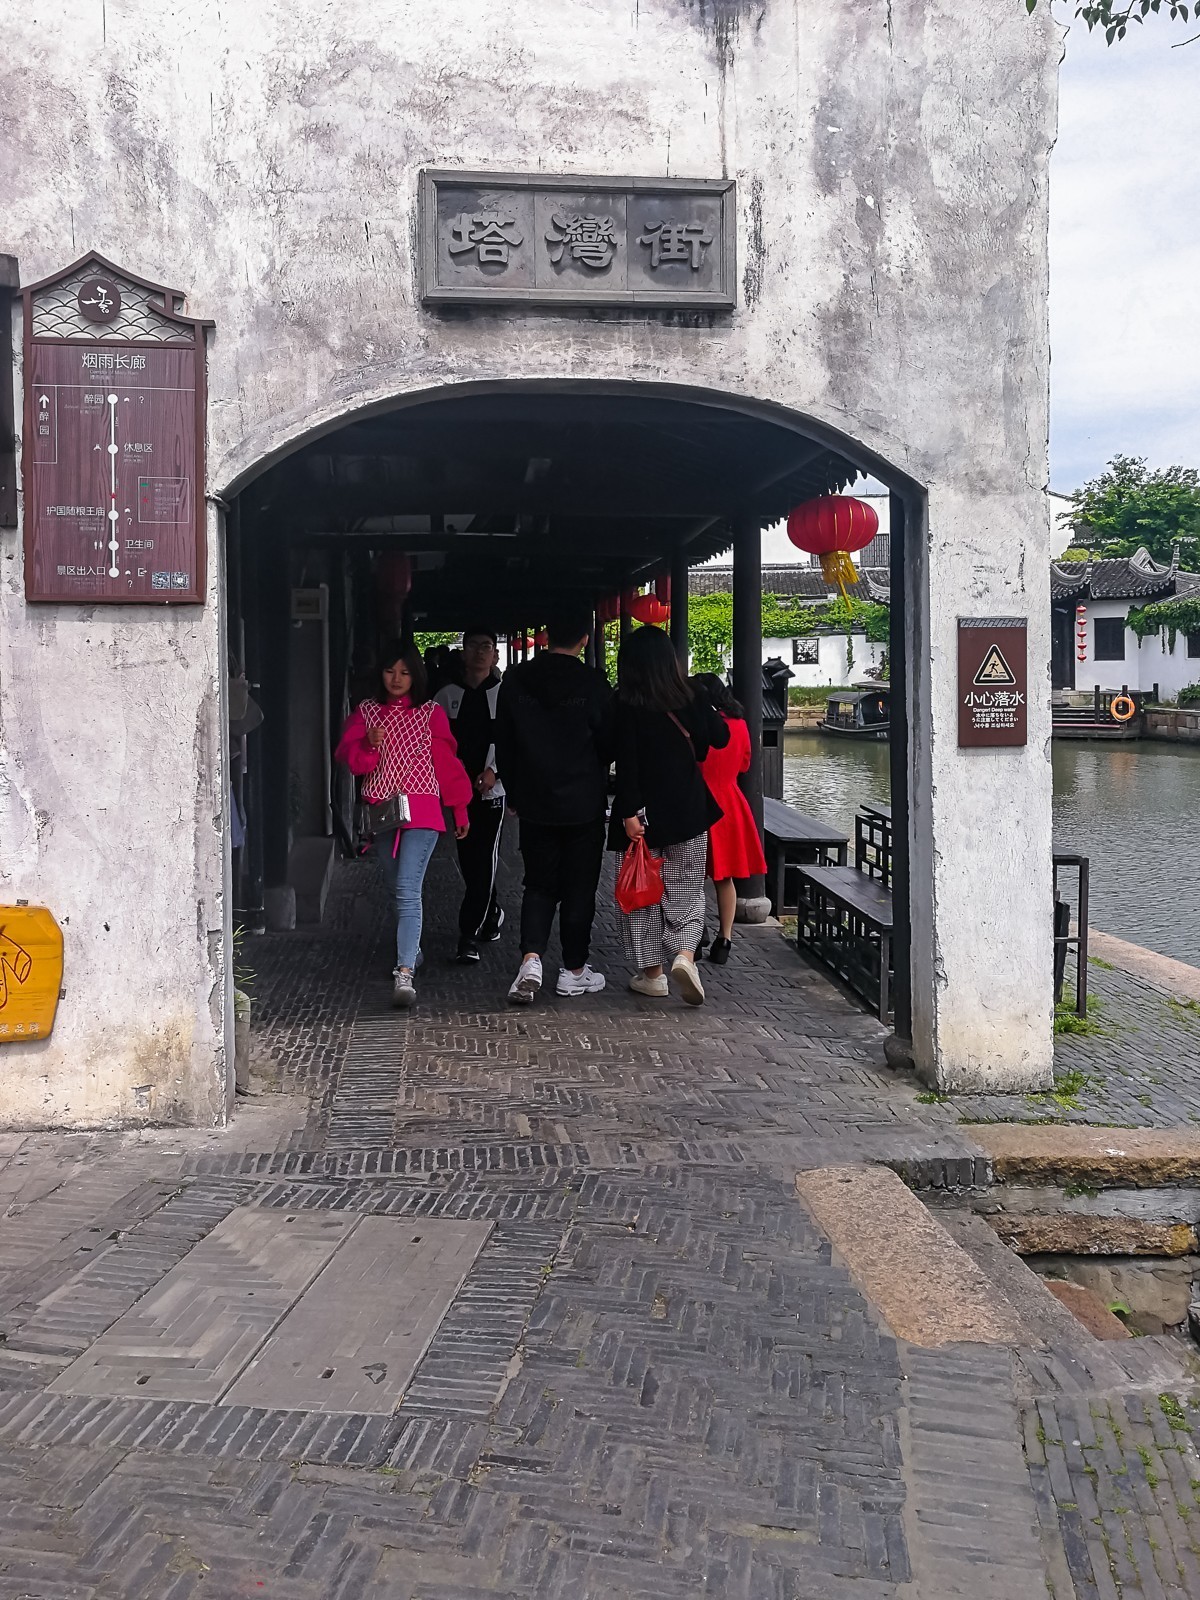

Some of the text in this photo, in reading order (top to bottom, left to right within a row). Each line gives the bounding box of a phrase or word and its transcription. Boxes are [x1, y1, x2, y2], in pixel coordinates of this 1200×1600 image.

[447, 211, 714, 269] 塔灣街
[82, 353, 146, 370] 烟雨长廊
[84, 394, 104, 405] 醉园
[39, 412, 49, 435] 醉园
[124, 443, 153, 453] 休息区
[46, 506, 105, 517] 护国随粮王庙
[125, 540, 154, 550] 卫生间
[57, 566, 106, 576] 景区出入口
[964, 691, 1025, 706] 小心落水
